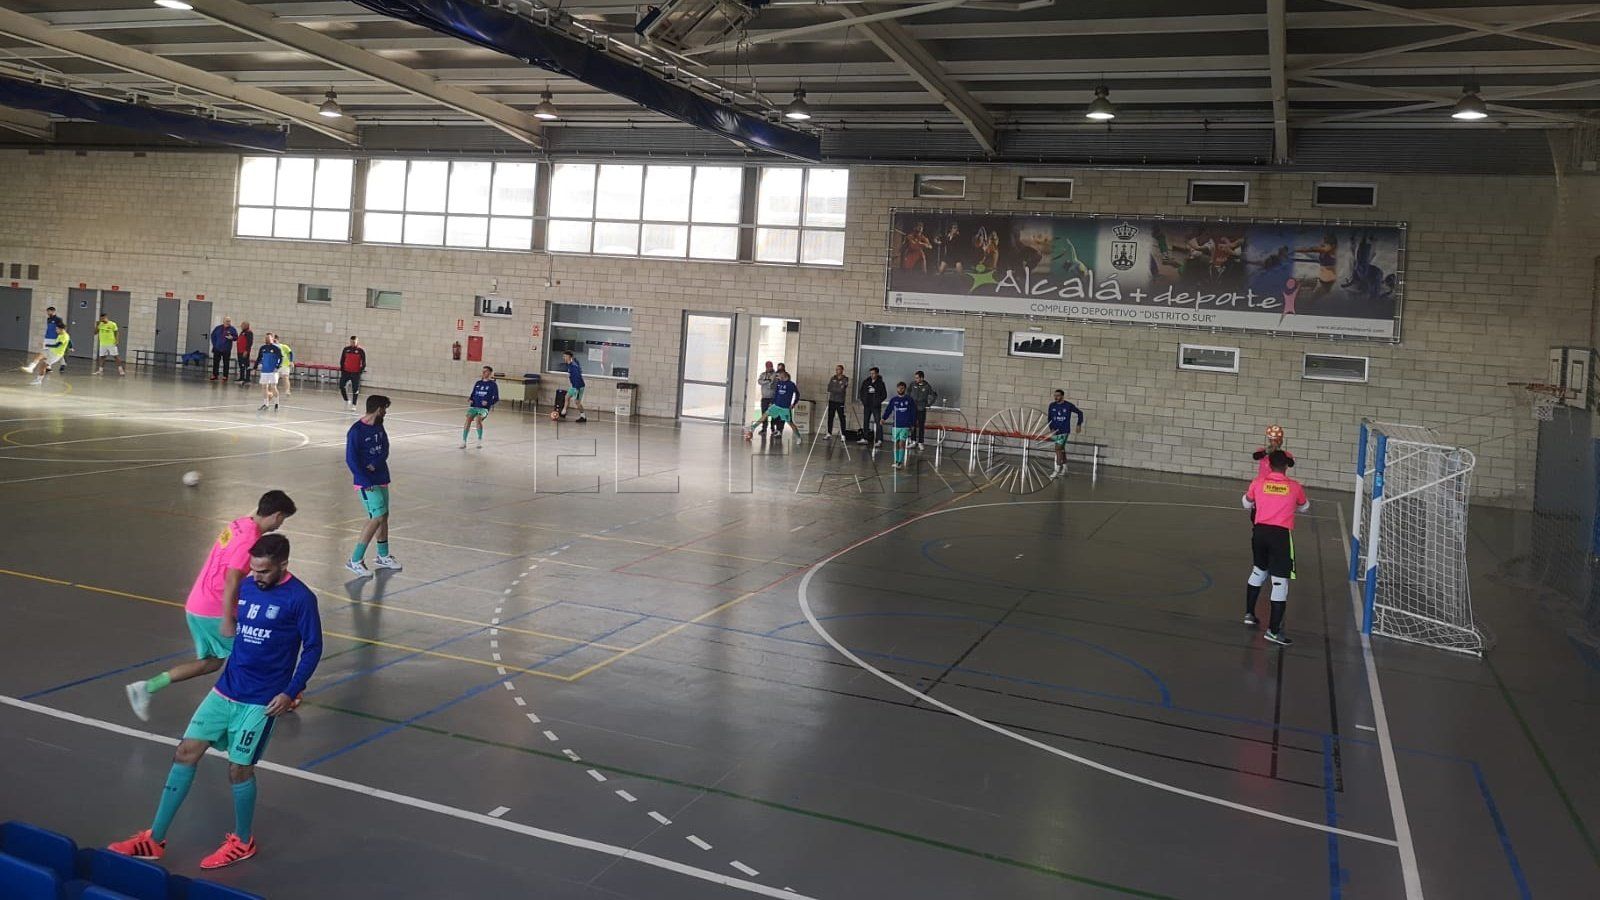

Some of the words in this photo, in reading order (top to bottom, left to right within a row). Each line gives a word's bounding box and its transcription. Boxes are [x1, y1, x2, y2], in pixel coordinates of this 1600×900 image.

[995, 266, 1122, 301] Alcalá
[1153, 285, 1282, 311] deporte
[1030, 303, 1079, 315] COMPLEJO
[1081, 306, 1137, 318] DEPORTIVO
[1140, 310, 1190, 321] "DISTRITO
[1192, 313, 1217, 323] SUR"
[246, 603, 261, 620] 16
[241, 624, 273, 639] NACEX
[239, 729, 256, 747] 16
